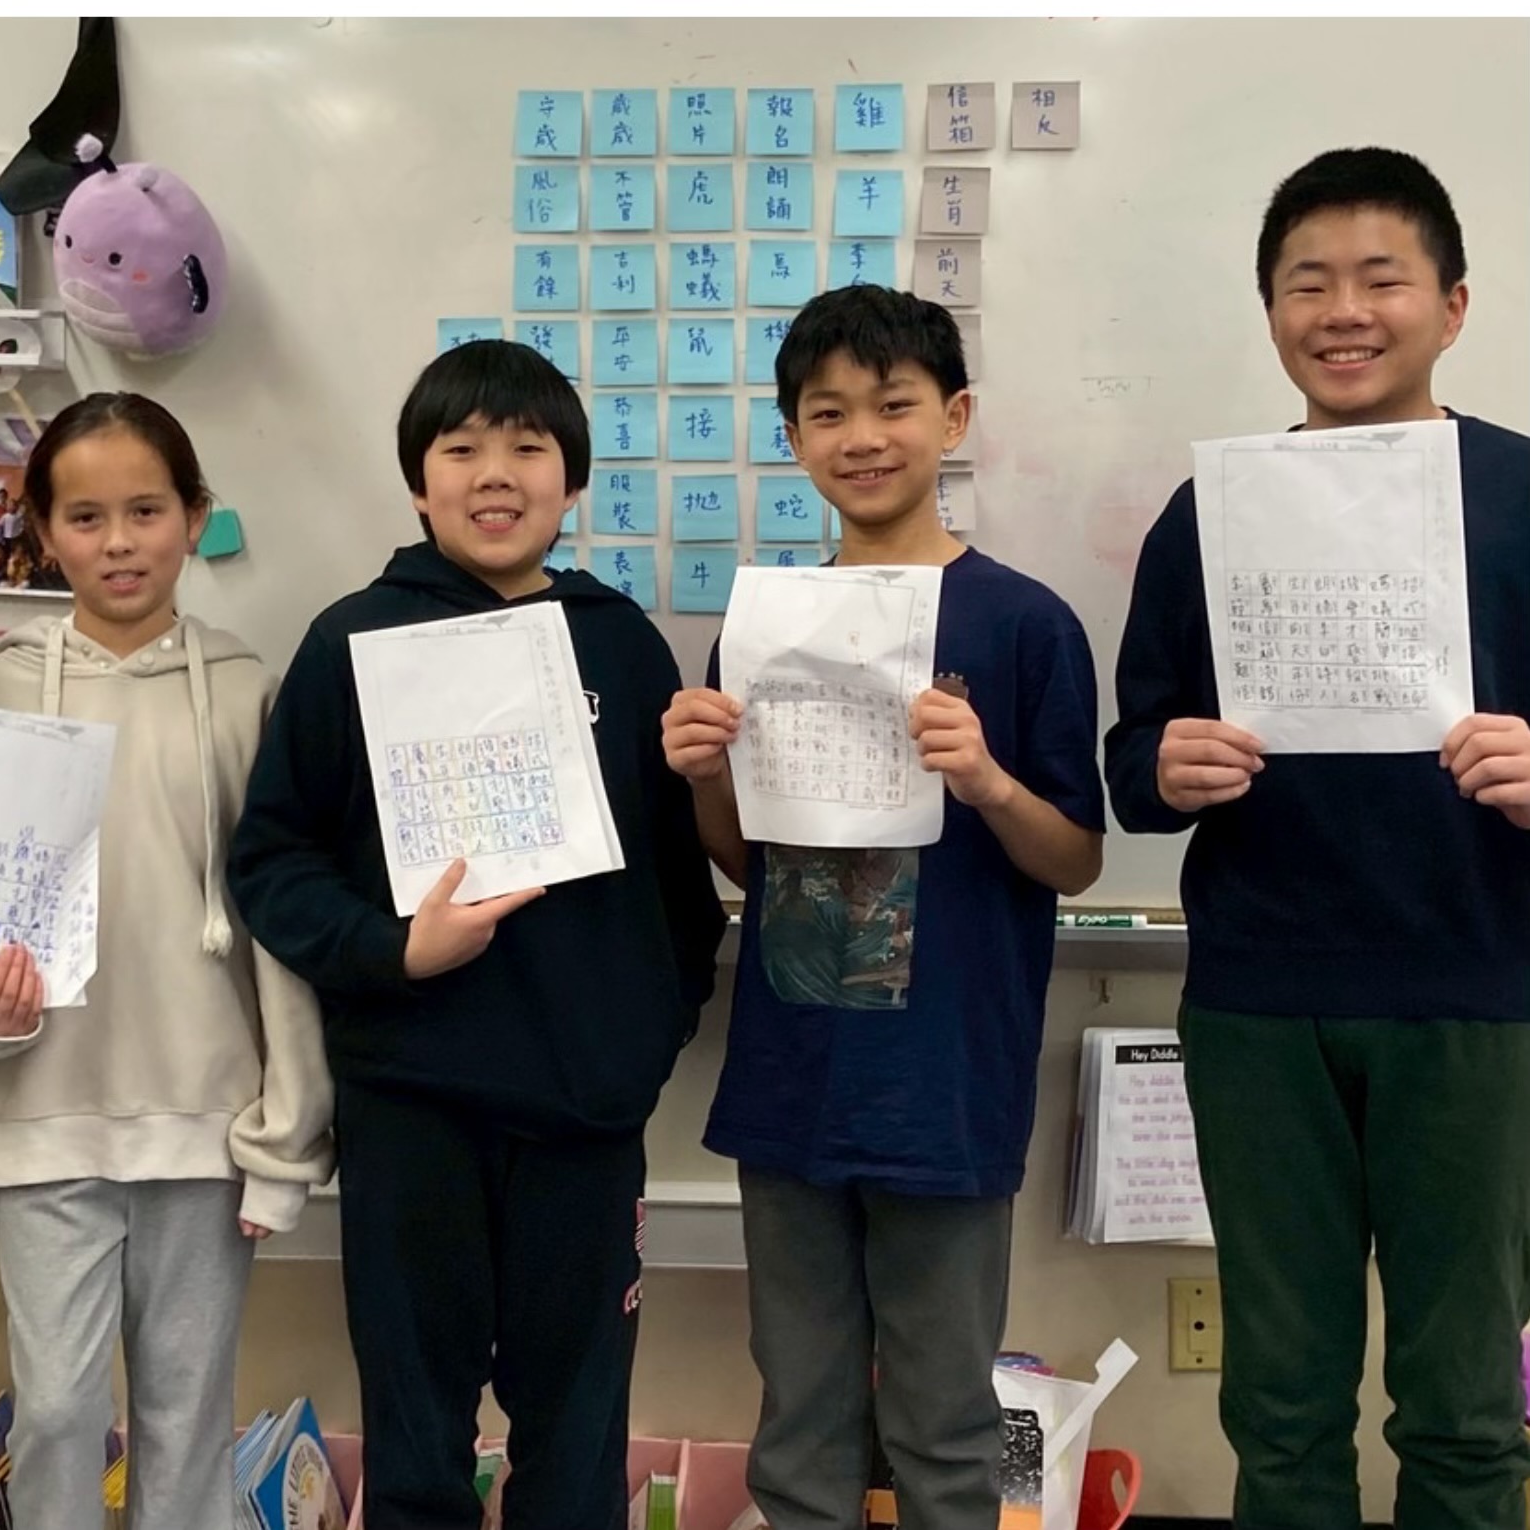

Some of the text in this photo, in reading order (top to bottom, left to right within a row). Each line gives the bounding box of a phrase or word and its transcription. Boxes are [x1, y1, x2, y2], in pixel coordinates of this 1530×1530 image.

[536, 97, 557, 148] 守歲
[687, 95, 712, 145] 照片
[766, 96, 792, 148] 報名
[853, 92, 886, 130] 雞
[948, 86, 973, 144] 信箱
[1033, 89, 1060, 135] 相反
[527, 171, 554, 224] 風俗
[615, 171, 633, 221] 不管
[689, 172, 713, 205] 虎
[766, 168, 791, 220] 朗誦
[859, 176, 880, 210] 羊
[944, 176, 962, 226] 生肖
[535, 251, 559, 297] 有餘
[612, 251, 635, 295] 吉利
[686, 249, 721, 303] 螞蟻
[770, 255, 791, 278] 馬
[937, 248, 961, 298] 前天
[612, 327, 635, 370] 平安
[690, 328, 713, 356] 鼠
[614, 398, 632, 451] 恭喜
[686, 410, 717, 439] 接
[610, 474, 636, 531] 服裝
[775, 498, 808, 520] 蛇
[692, 561, 710, 586] 牛
[1131, 1048, 1179, 1062] Hey Diddle
